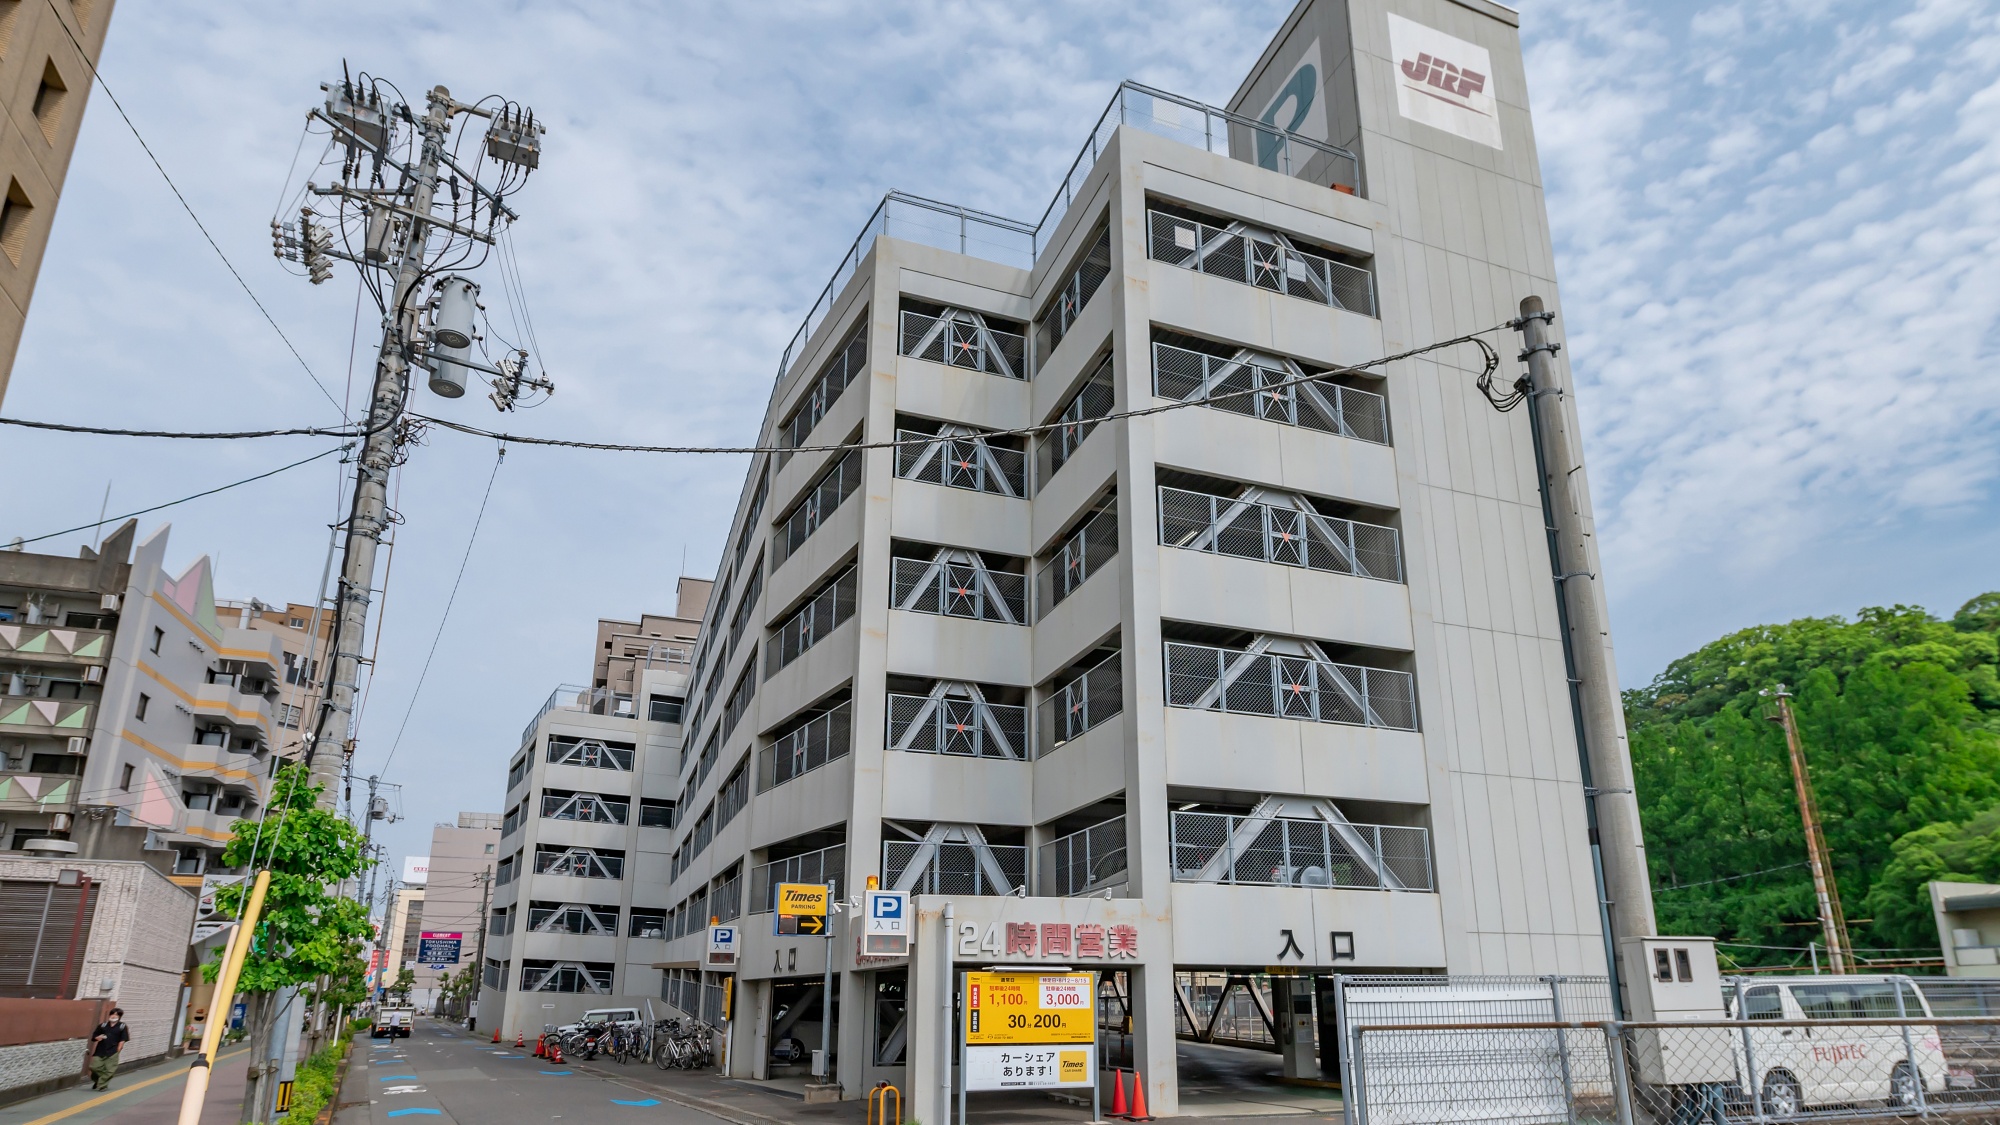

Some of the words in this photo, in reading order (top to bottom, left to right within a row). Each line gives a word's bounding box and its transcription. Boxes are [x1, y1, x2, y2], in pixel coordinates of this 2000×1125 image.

[1256, 63, 1317, 172] P
[785, 890, 822, 902] Times
[877, 898, 898, 916] P
[875, 921, 900, 930] 入口
[716, 930, 730, 941] P
[959, 921, 1138, 958] 24時間営業
[1277, 929, 1355, 961] 入口
[774, 948, 797, 973] 入口
[1001, 1052, 1055, 1063] カーシェア
[1813, 1044, 1867, 1064] FUJITEC
[1003, 1066, 1052, 1077] あります!
